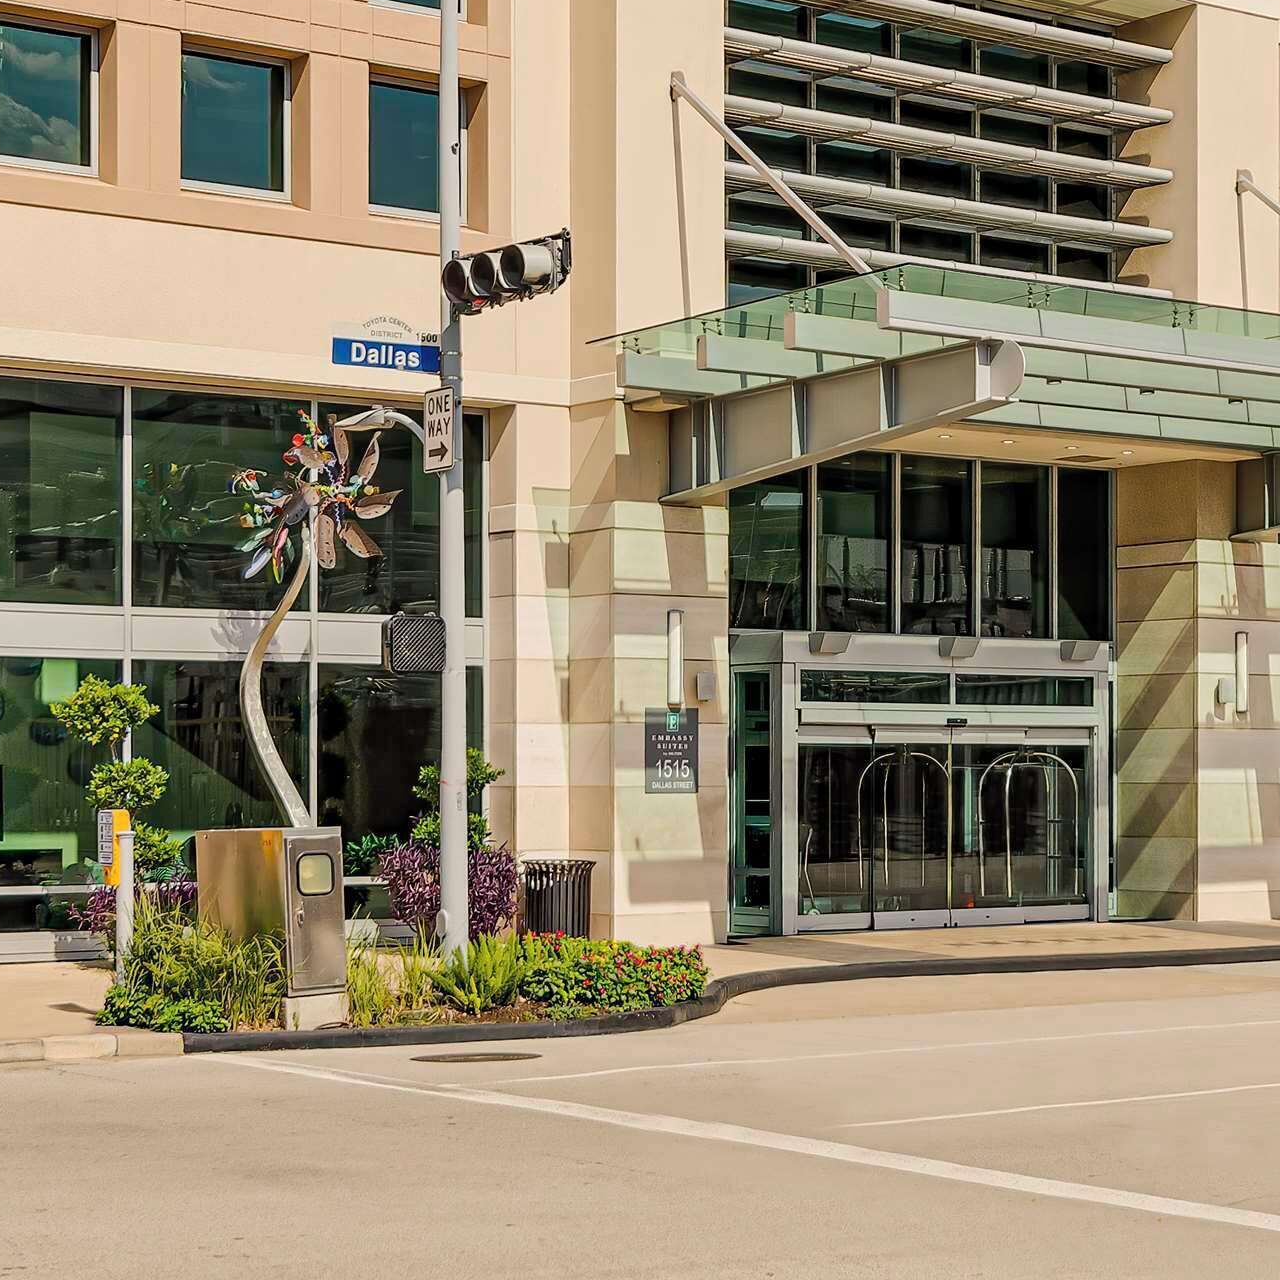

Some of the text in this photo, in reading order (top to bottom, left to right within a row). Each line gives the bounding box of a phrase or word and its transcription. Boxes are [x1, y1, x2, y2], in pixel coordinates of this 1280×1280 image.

[362, 316, 413, 334] TOYOTA CENTER
[370, 329, 403, 338] DISTRICT
[416, 332, 438, 342] 1500
[351, 342, 420, 368] Dallas
[428, 394, 450, 415] ONE
[428, 416, 451, 438] WAY
[656, 759, 690, 778] 1515
[651, 781, 694, 790] DALLAS STREET
